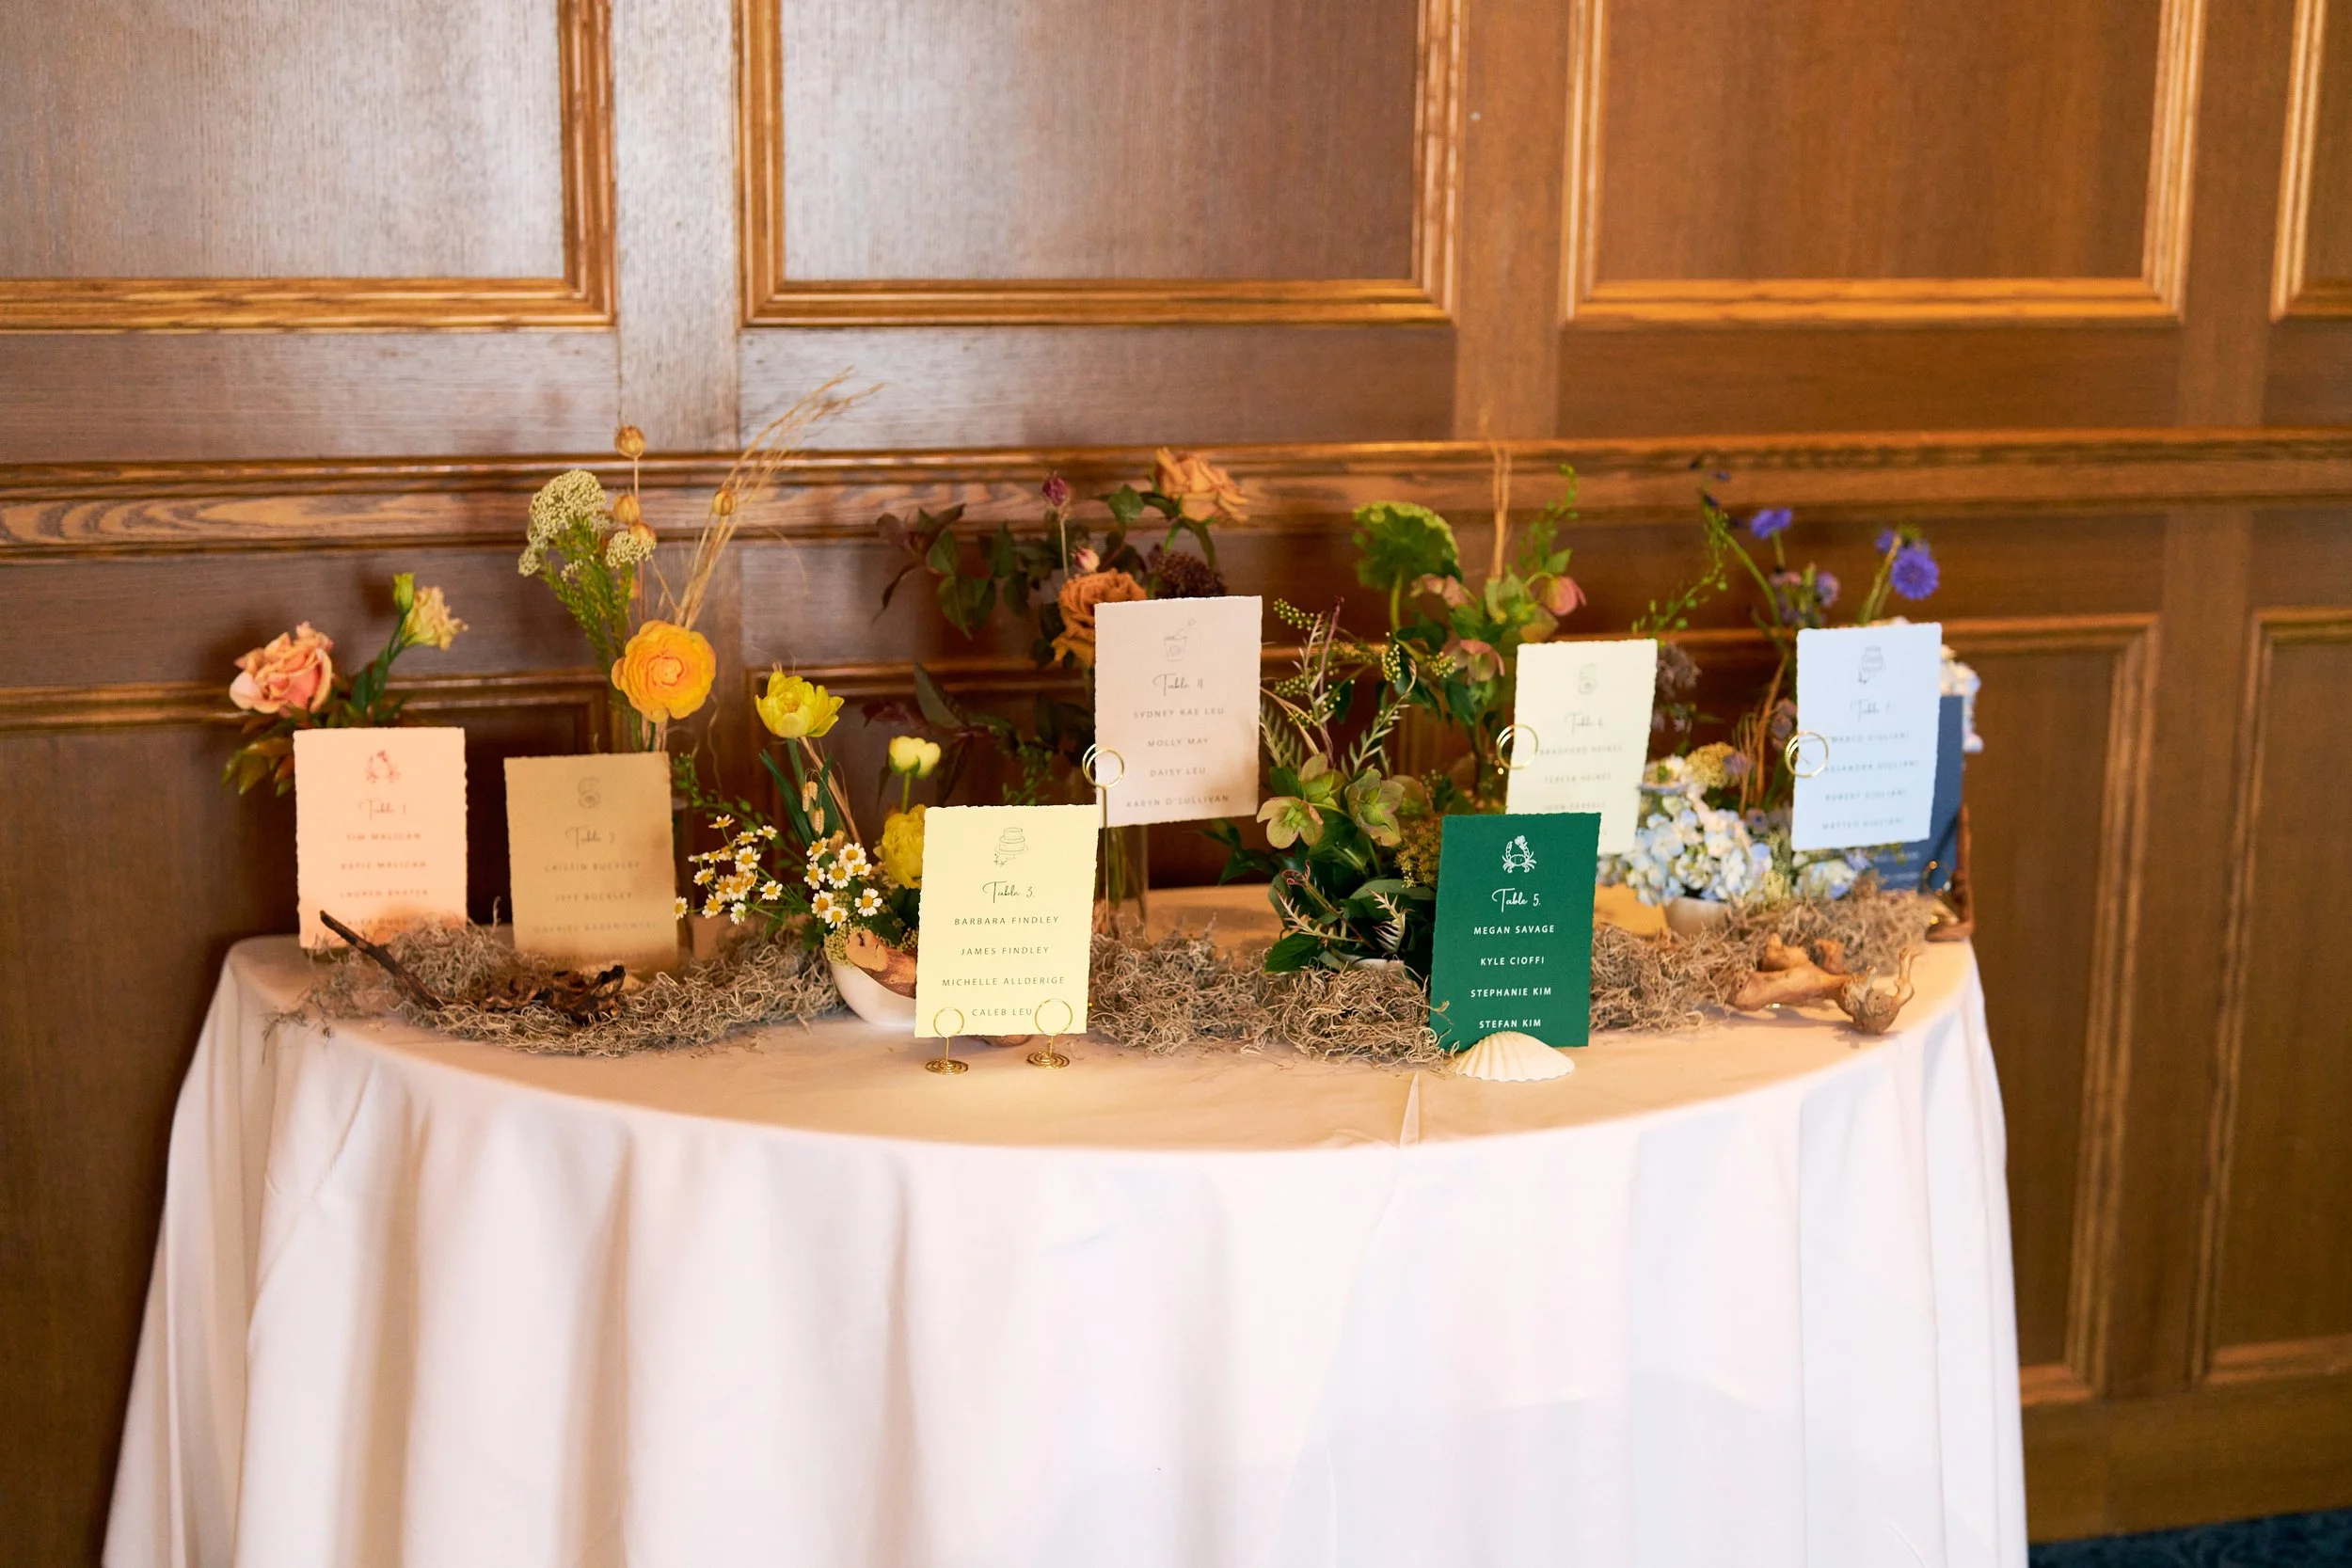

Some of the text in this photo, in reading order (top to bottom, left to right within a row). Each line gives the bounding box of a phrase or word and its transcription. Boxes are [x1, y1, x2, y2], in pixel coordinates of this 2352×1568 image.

[1152, 673, 1190, 697] Table
[1133, 707, 1225, 720] SYDNEY RAE LEU
[1147, 738, 1183, 747] MOLLY
[1150, 768, 1206, 777] DAISY LEU
[1126, 799, 1161, 808] KARYN
[982, 880, 1021, 904] Table
[1491, 888, 1542, 913] Table 5.
[954, 915, 1061, 927] BARBARA FINDLEY
[1473, 925, 1555, 935] MEGAN SAVAGE
[961, 946, 1050, 956] JAMES FINDLEY
[1480, 956, 1545, 966] KYLE CIOFFI
[942, 975, 1065, 987] MICHELLE ALLDERIGE
[1470, 987, 1551, 998] STEPHANIE KIM
[971, 1007, 1033, 1017] CALEB LEU
[1479, 1019, 1541, 1029] STEFAN KIM
